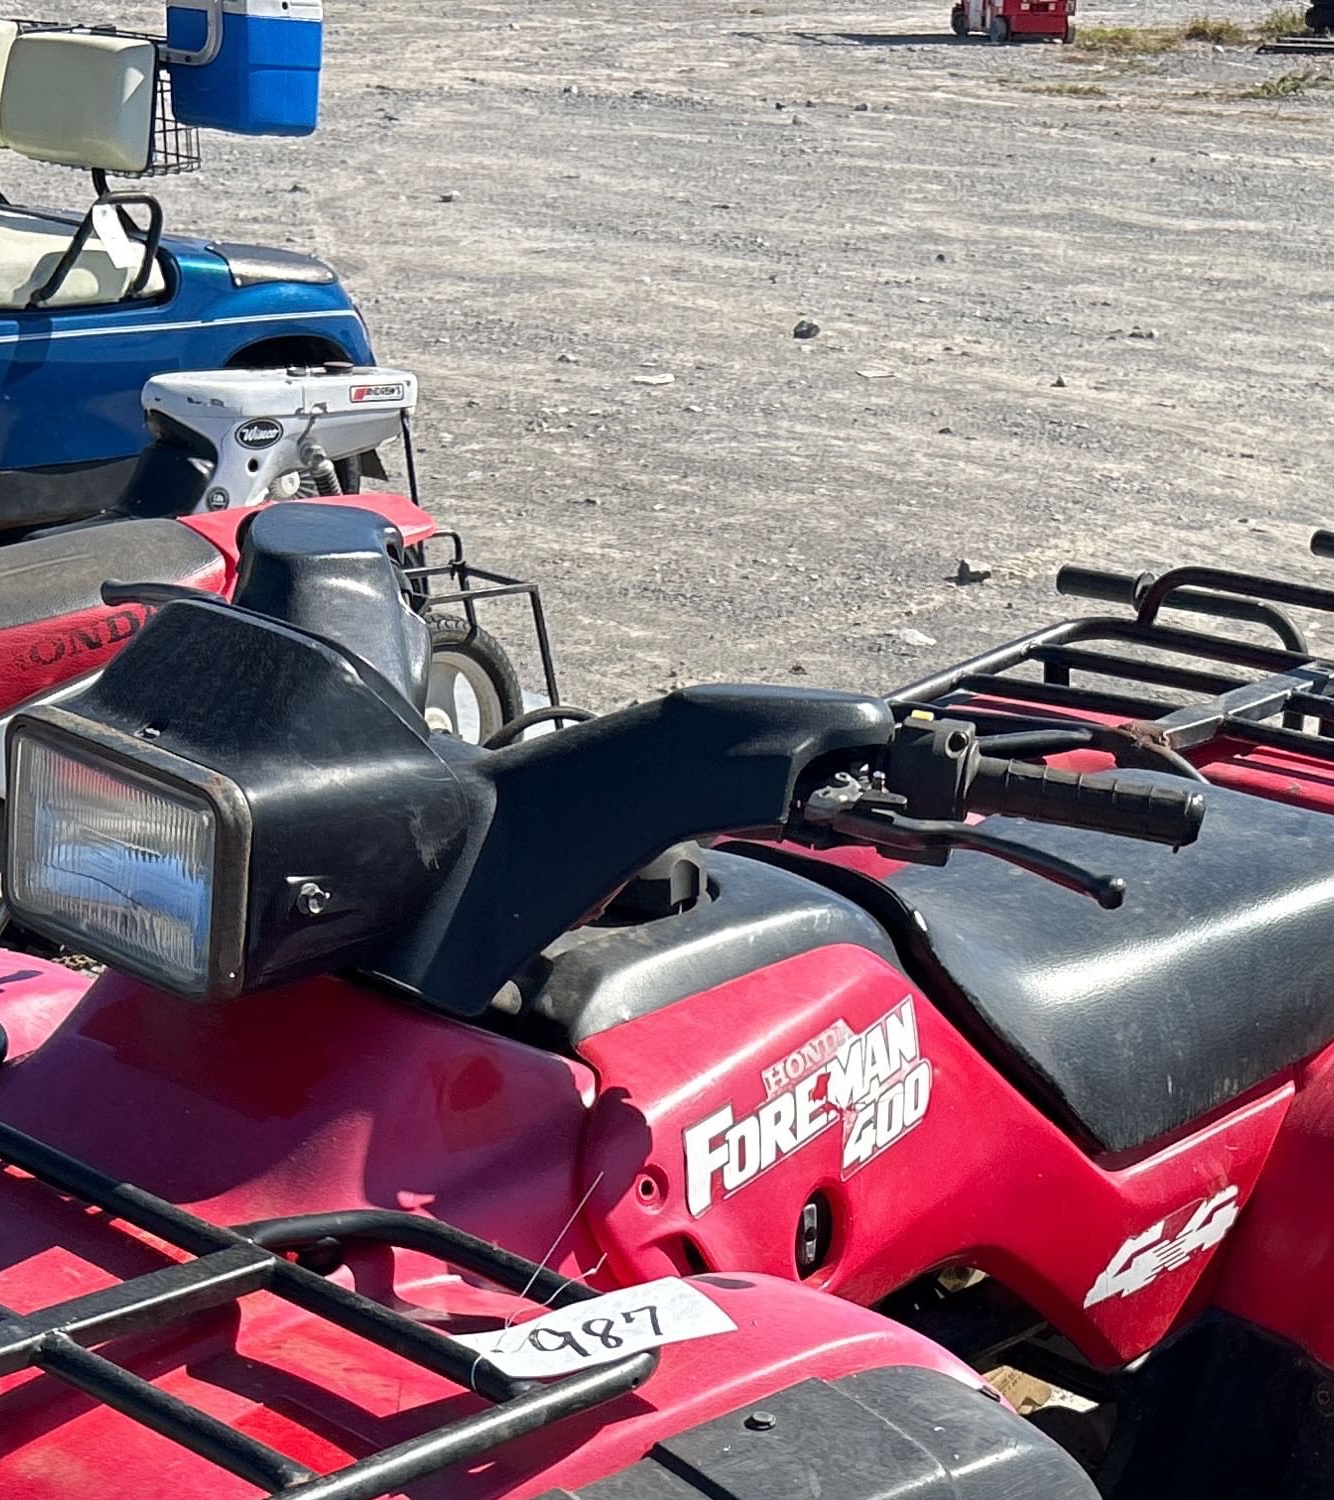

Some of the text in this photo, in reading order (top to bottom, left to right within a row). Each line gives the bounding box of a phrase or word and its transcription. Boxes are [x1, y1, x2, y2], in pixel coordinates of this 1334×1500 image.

[764, 1022, 855, 1092] HONDA
[683, 998, 918, 1218] FOREMAN
[843, 1060, 932, 1169] 400
[528, 1306, 663, 1357] 987
